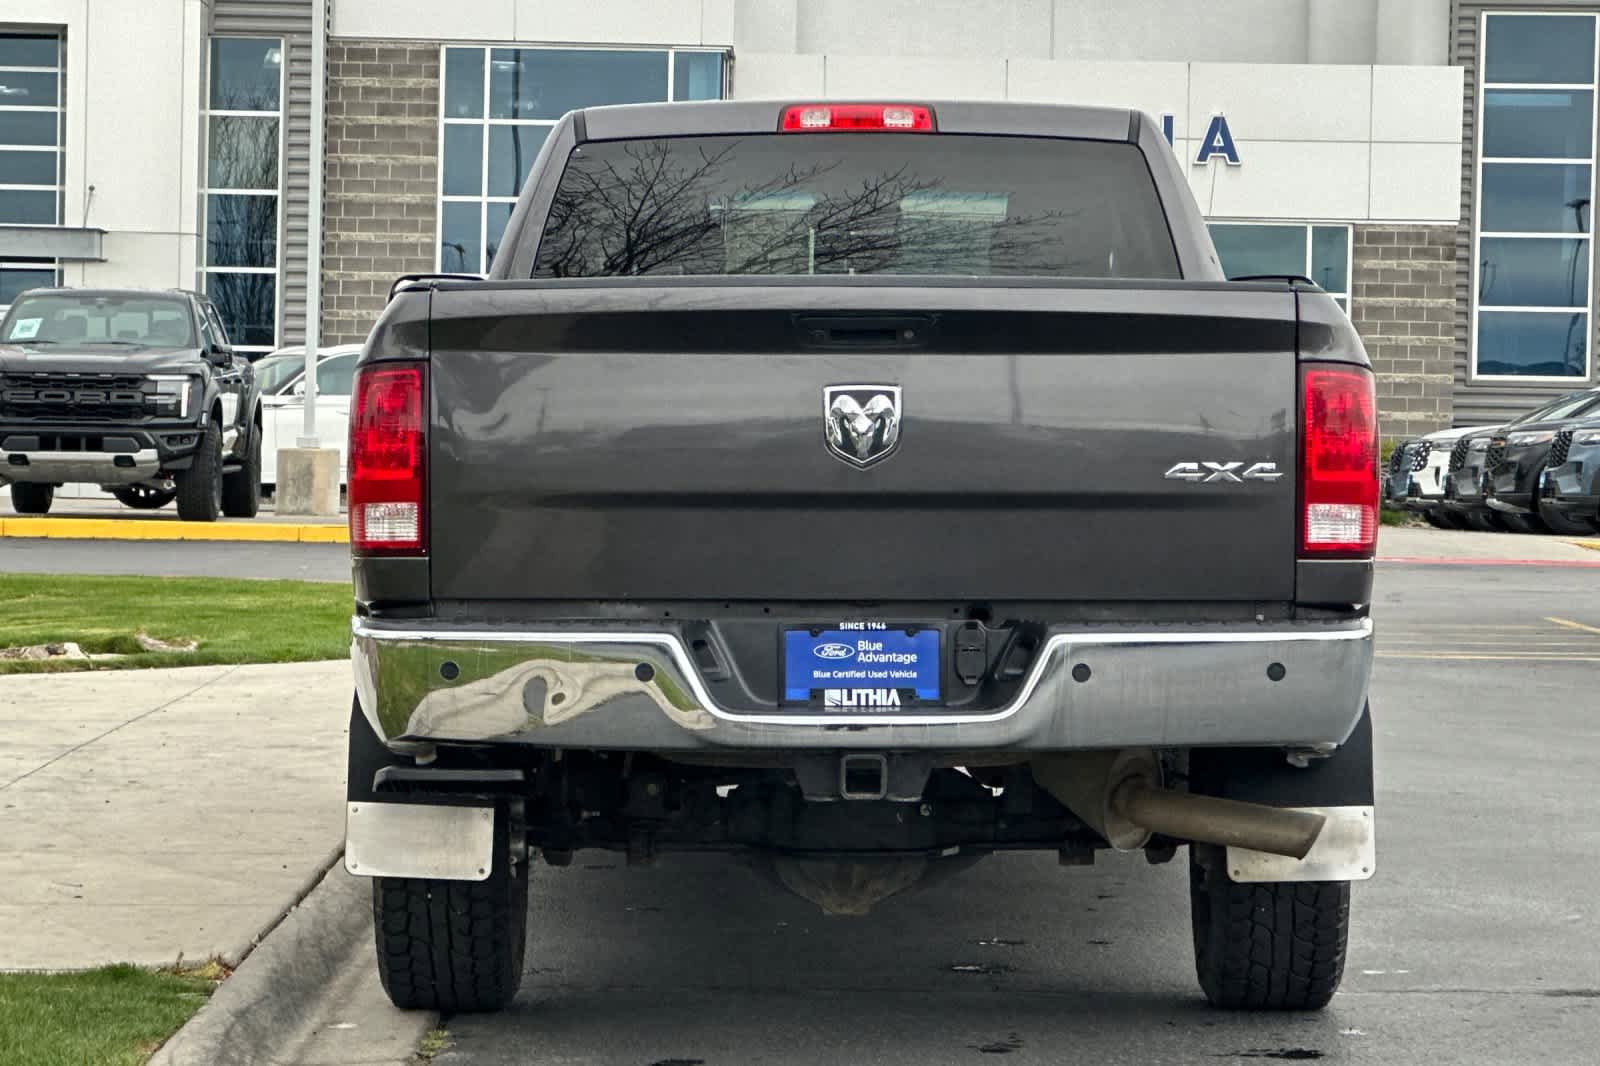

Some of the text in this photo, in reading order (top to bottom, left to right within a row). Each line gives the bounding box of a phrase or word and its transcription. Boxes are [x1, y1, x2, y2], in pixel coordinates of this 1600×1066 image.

[839, 622, 887, 630] SINCE 1946
[821, 645, 847, 657] Ford
[857, 640, 883, 651] Blue
[857, 652, 918, 665] Advantage
[813, 670, 918, 678] Blue Certified Used Vehicle
[841, 689, 901, 706] LITHIA
